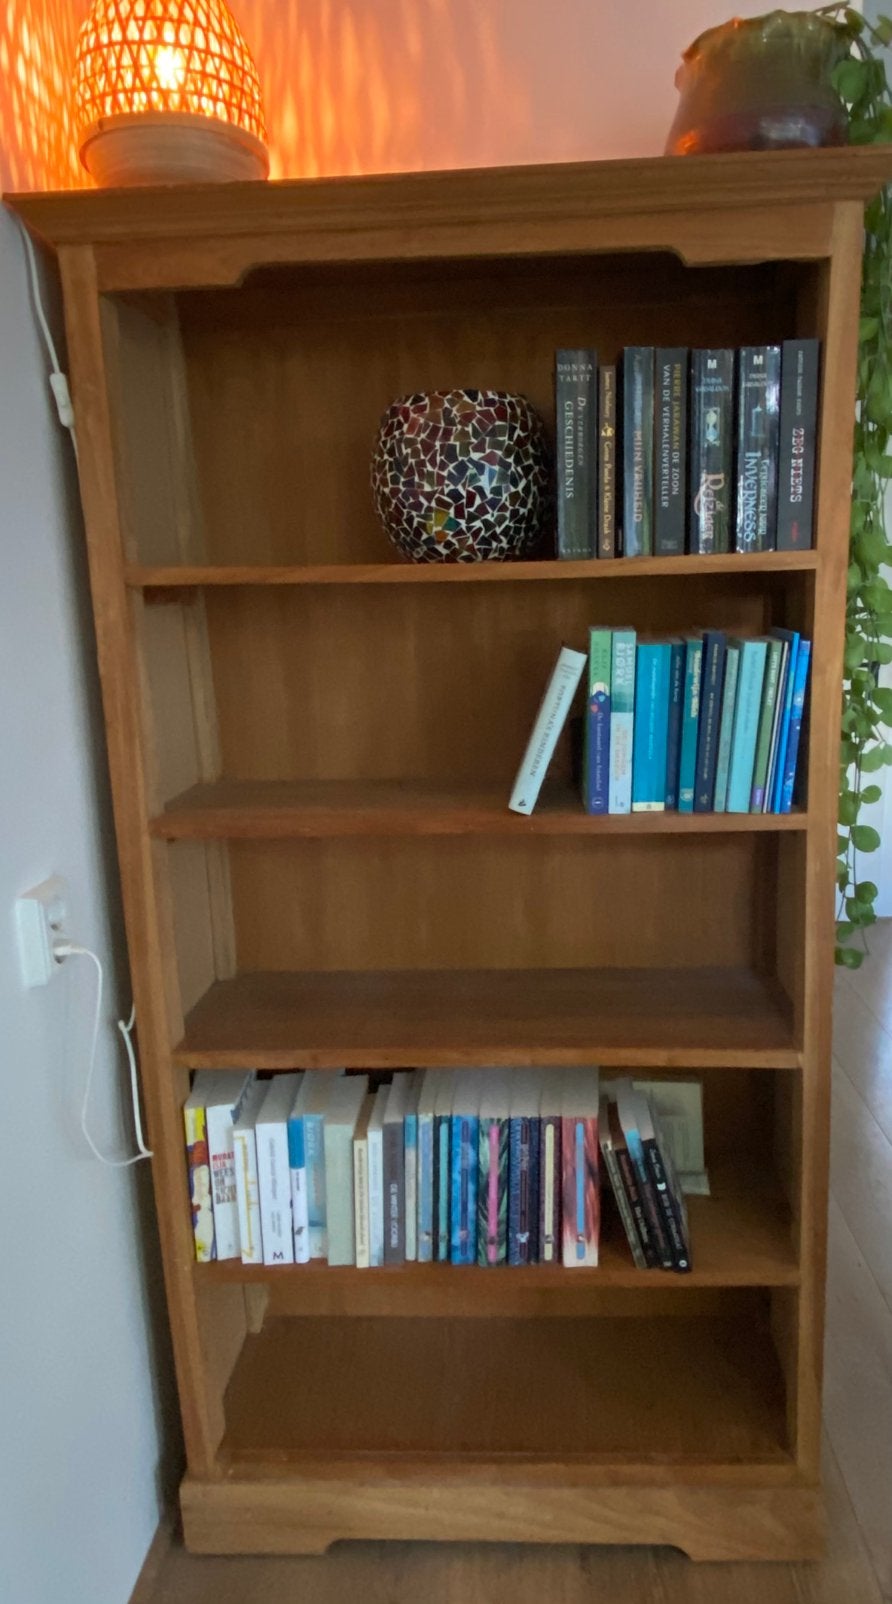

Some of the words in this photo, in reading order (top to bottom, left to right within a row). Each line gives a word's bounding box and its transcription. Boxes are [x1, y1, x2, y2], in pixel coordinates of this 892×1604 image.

[558, 363, 593, 372] DONNA
[707, 359, 717, 369] M
[753, 355, 763, 365] M
[559, 374, 592, 382] TARTT
[662, 365, 671, 386] VAN
[673, 363, 681, 397] PIERRE
[662, 389, 670, 402] DE
[672, 401, 680, 450] JARAWAN
[564, 401, 575, 499] GESCHIEDENIS
[633, 430, 643, 461] MIJN
[791, 428, 804, 455] ZEG
[661, 406, 670, 508] VERHALENVERTELLER
[671, 452, 680, 464] DE
[603, 463, 612, 484] Panda
[671, 468, 680, 495] ZOON
[790, 458, 803, 503] NIETS
[603, 492, 612, 513] Kleine
[633, 466, 644, 522] VRIJHEID
[615, 642, 626, 685] BJØRK
[625, 642, 634, 685] SAMUEL
[390, 1194, 398, 1217] WINTER
